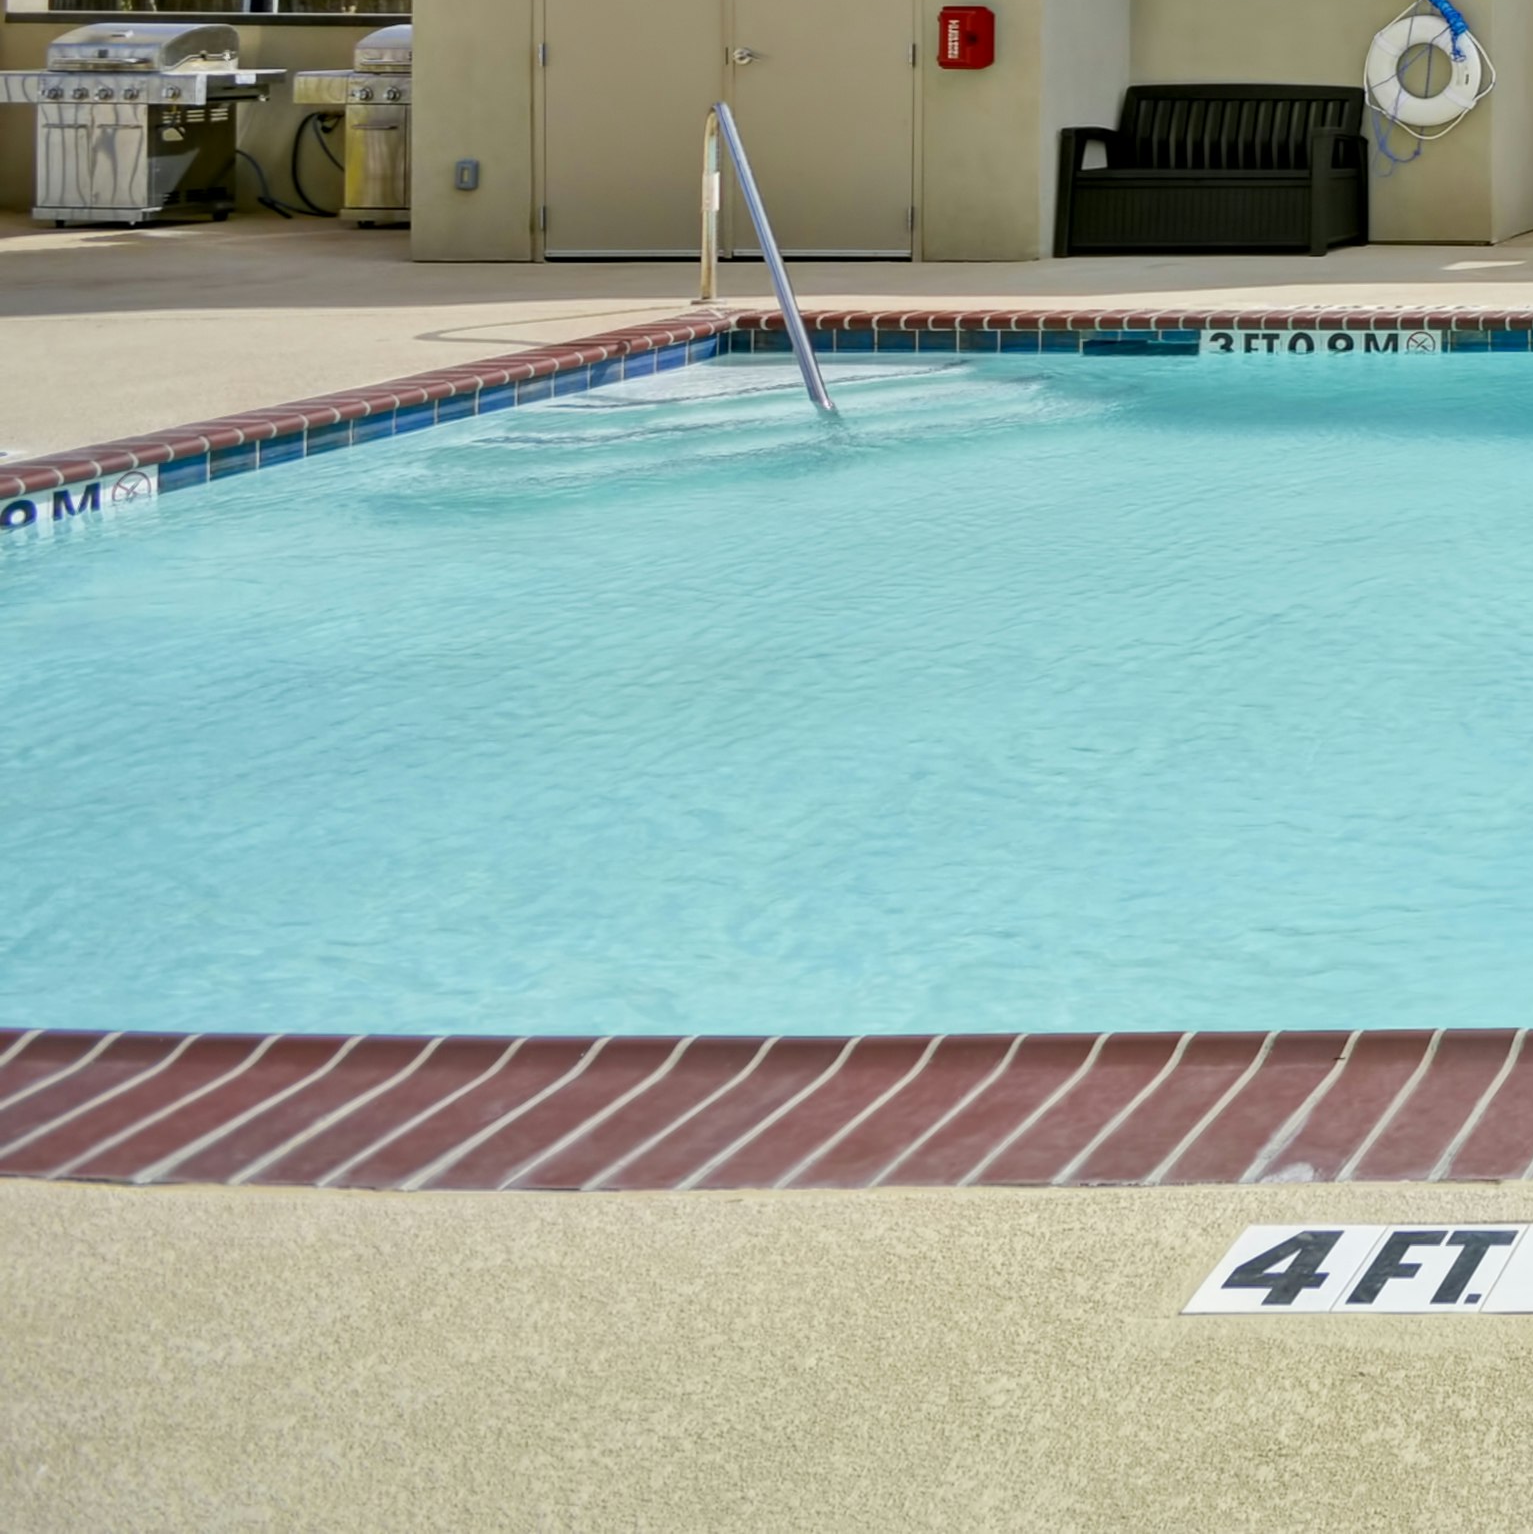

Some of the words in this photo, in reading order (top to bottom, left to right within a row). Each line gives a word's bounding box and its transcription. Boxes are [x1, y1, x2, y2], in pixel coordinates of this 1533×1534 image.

[53, 482, 101, 521] M
[1220, 1230, 1345, 1305] 4
[1345, 1230, 1519, 1305] FT.
